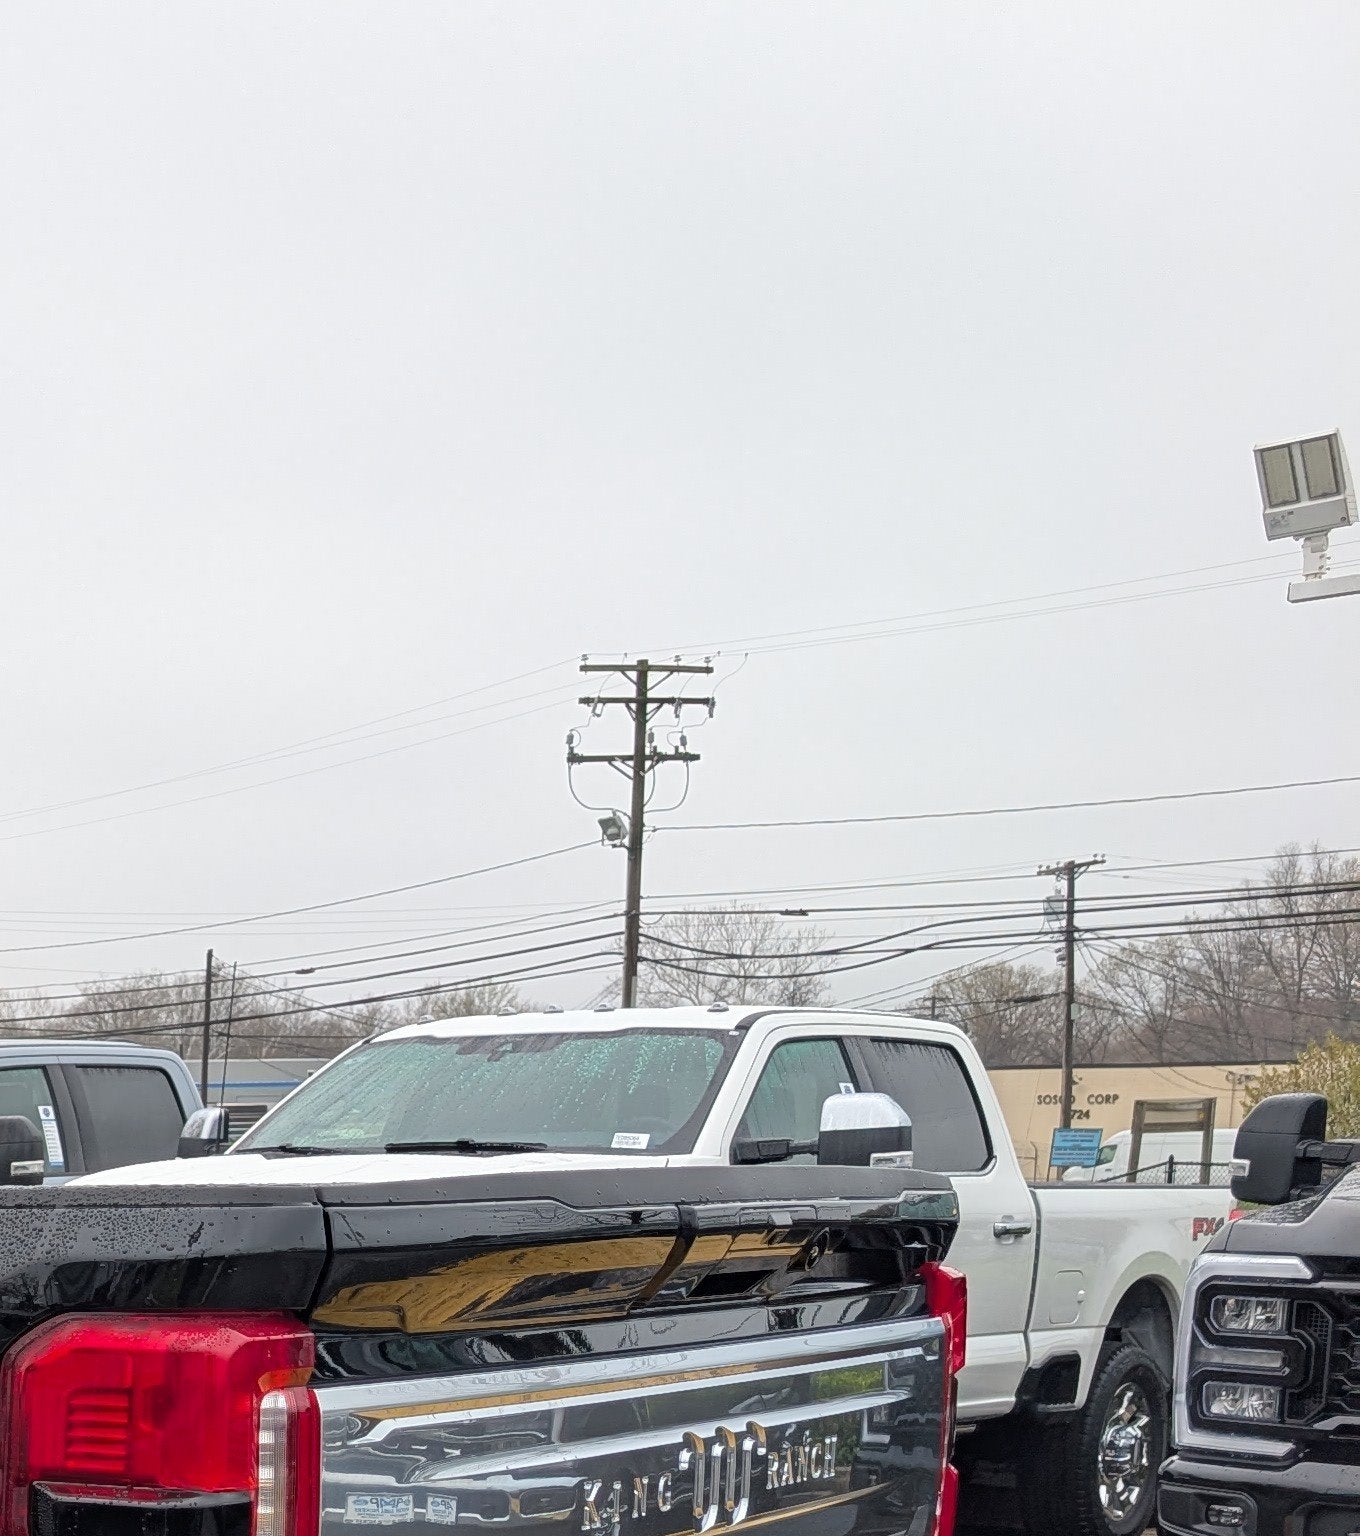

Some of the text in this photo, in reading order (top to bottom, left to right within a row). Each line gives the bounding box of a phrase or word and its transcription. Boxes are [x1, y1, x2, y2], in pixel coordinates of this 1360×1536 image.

[1037, 1094, 1119, 1105] SOSO CORP
[581, 1434, 838, 1531] KING RANCH
